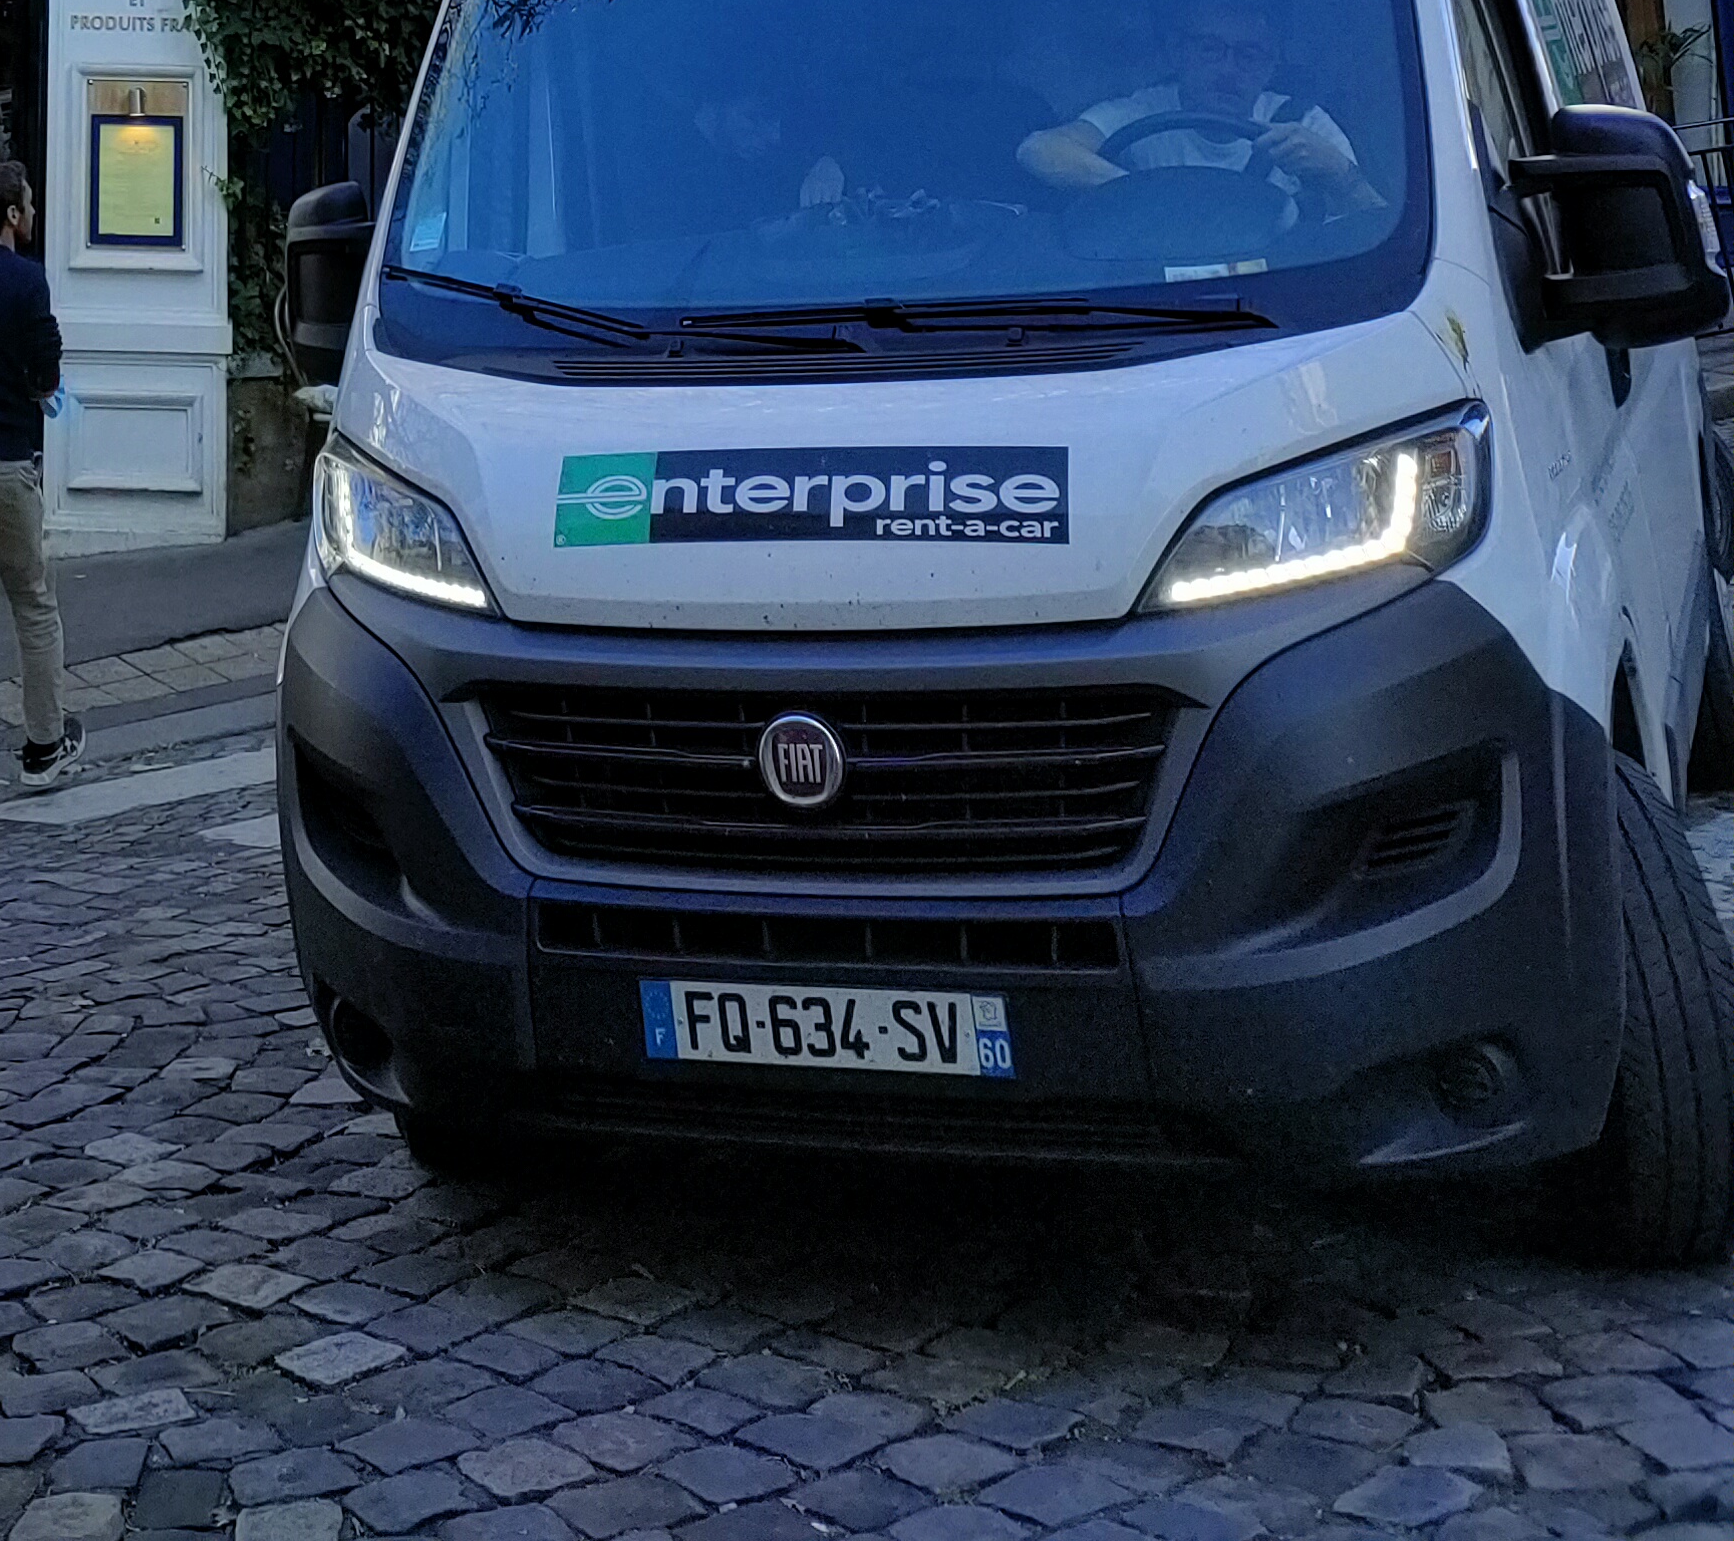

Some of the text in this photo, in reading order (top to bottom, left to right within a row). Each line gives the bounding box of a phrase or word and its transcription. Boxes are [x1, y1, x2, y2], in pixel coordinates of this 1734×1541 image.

[69, 14, 193, 34] PRODUITS FRA
[557, 460, 1061, 528] enterprise
[876, 516, 1059, 539] rent-a-car
[777, 743, 823, 783] FIAT
[654, 1027, 666, 1046] F
[684, 990, 958, 1064] FQ-634-SV
[978, 1036, 1012, 1069] 60
